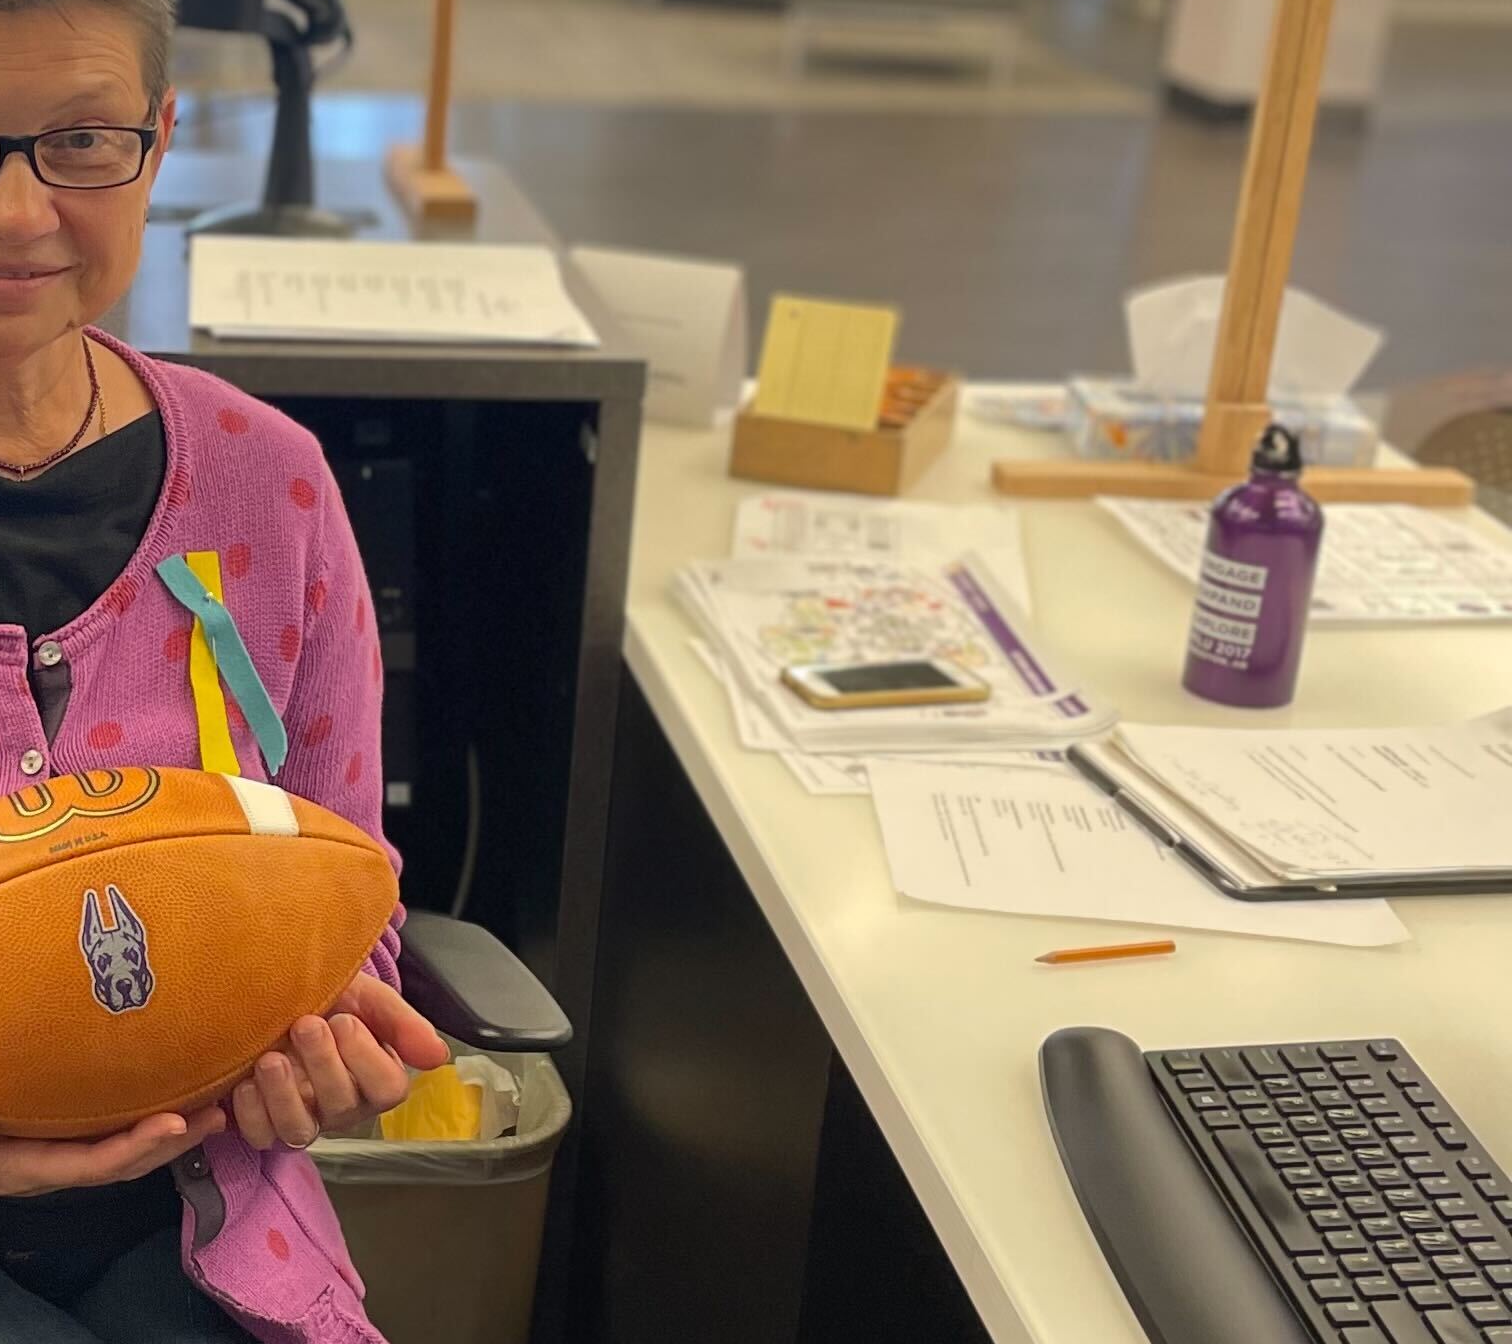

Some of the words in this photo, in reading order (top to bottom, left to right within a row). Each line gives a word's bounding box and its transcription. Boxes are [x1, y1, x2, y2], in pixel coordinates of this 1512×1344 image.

[1204, 557, 1261, 584] NGAGE
[1199, 587, 1257, 611] PAND
[1194, 614, 1252, 640] PLORE
